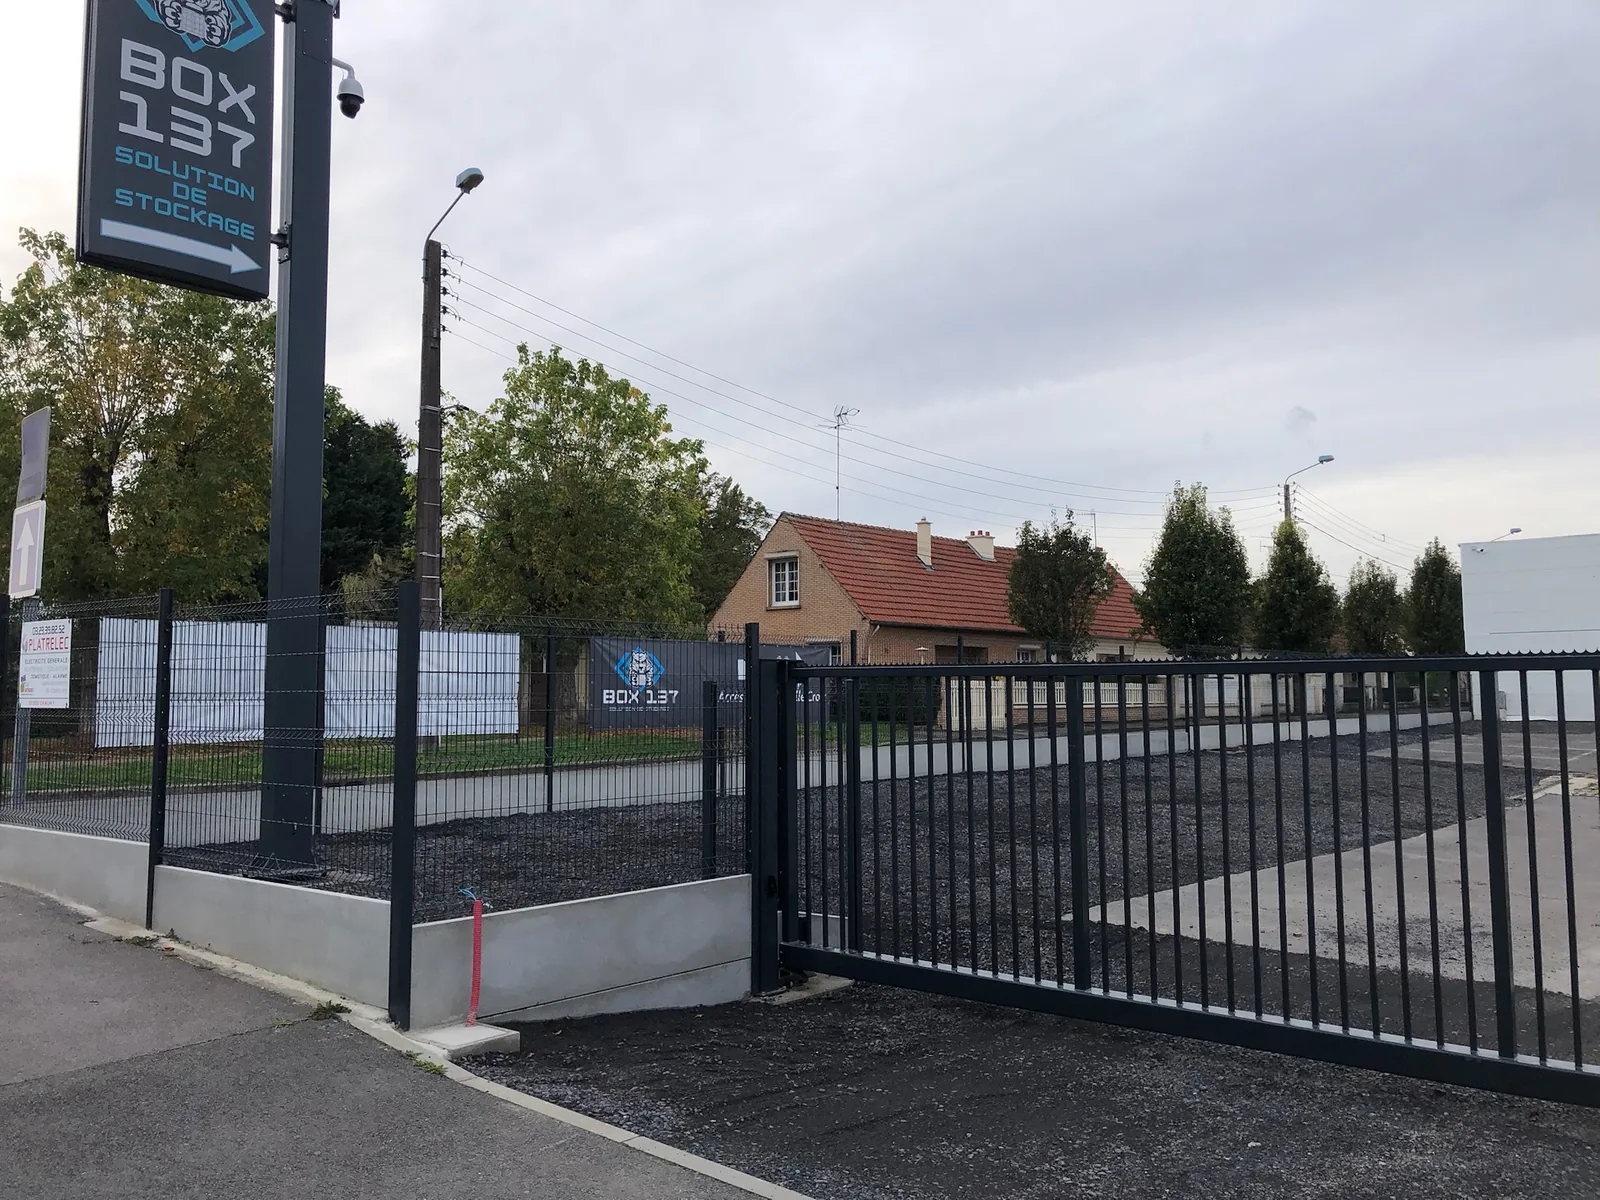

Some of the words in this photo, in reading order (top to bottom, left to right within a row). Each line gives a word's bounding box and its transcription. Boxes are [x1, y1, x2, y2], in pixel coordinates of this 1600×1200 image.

[120, 38, 256, 124] BOX
[118, 90, 256, 168] 137
[115, 145, 255, 201] SOLUTION
[172, 181, 207, 206] DE
[115, 188, 255, 241] STOCKAGE
[28, 637, 69, 651] PLATRELEC
[602, 689, 639, 704] BOX
[646, 689, 679, 704] 137
